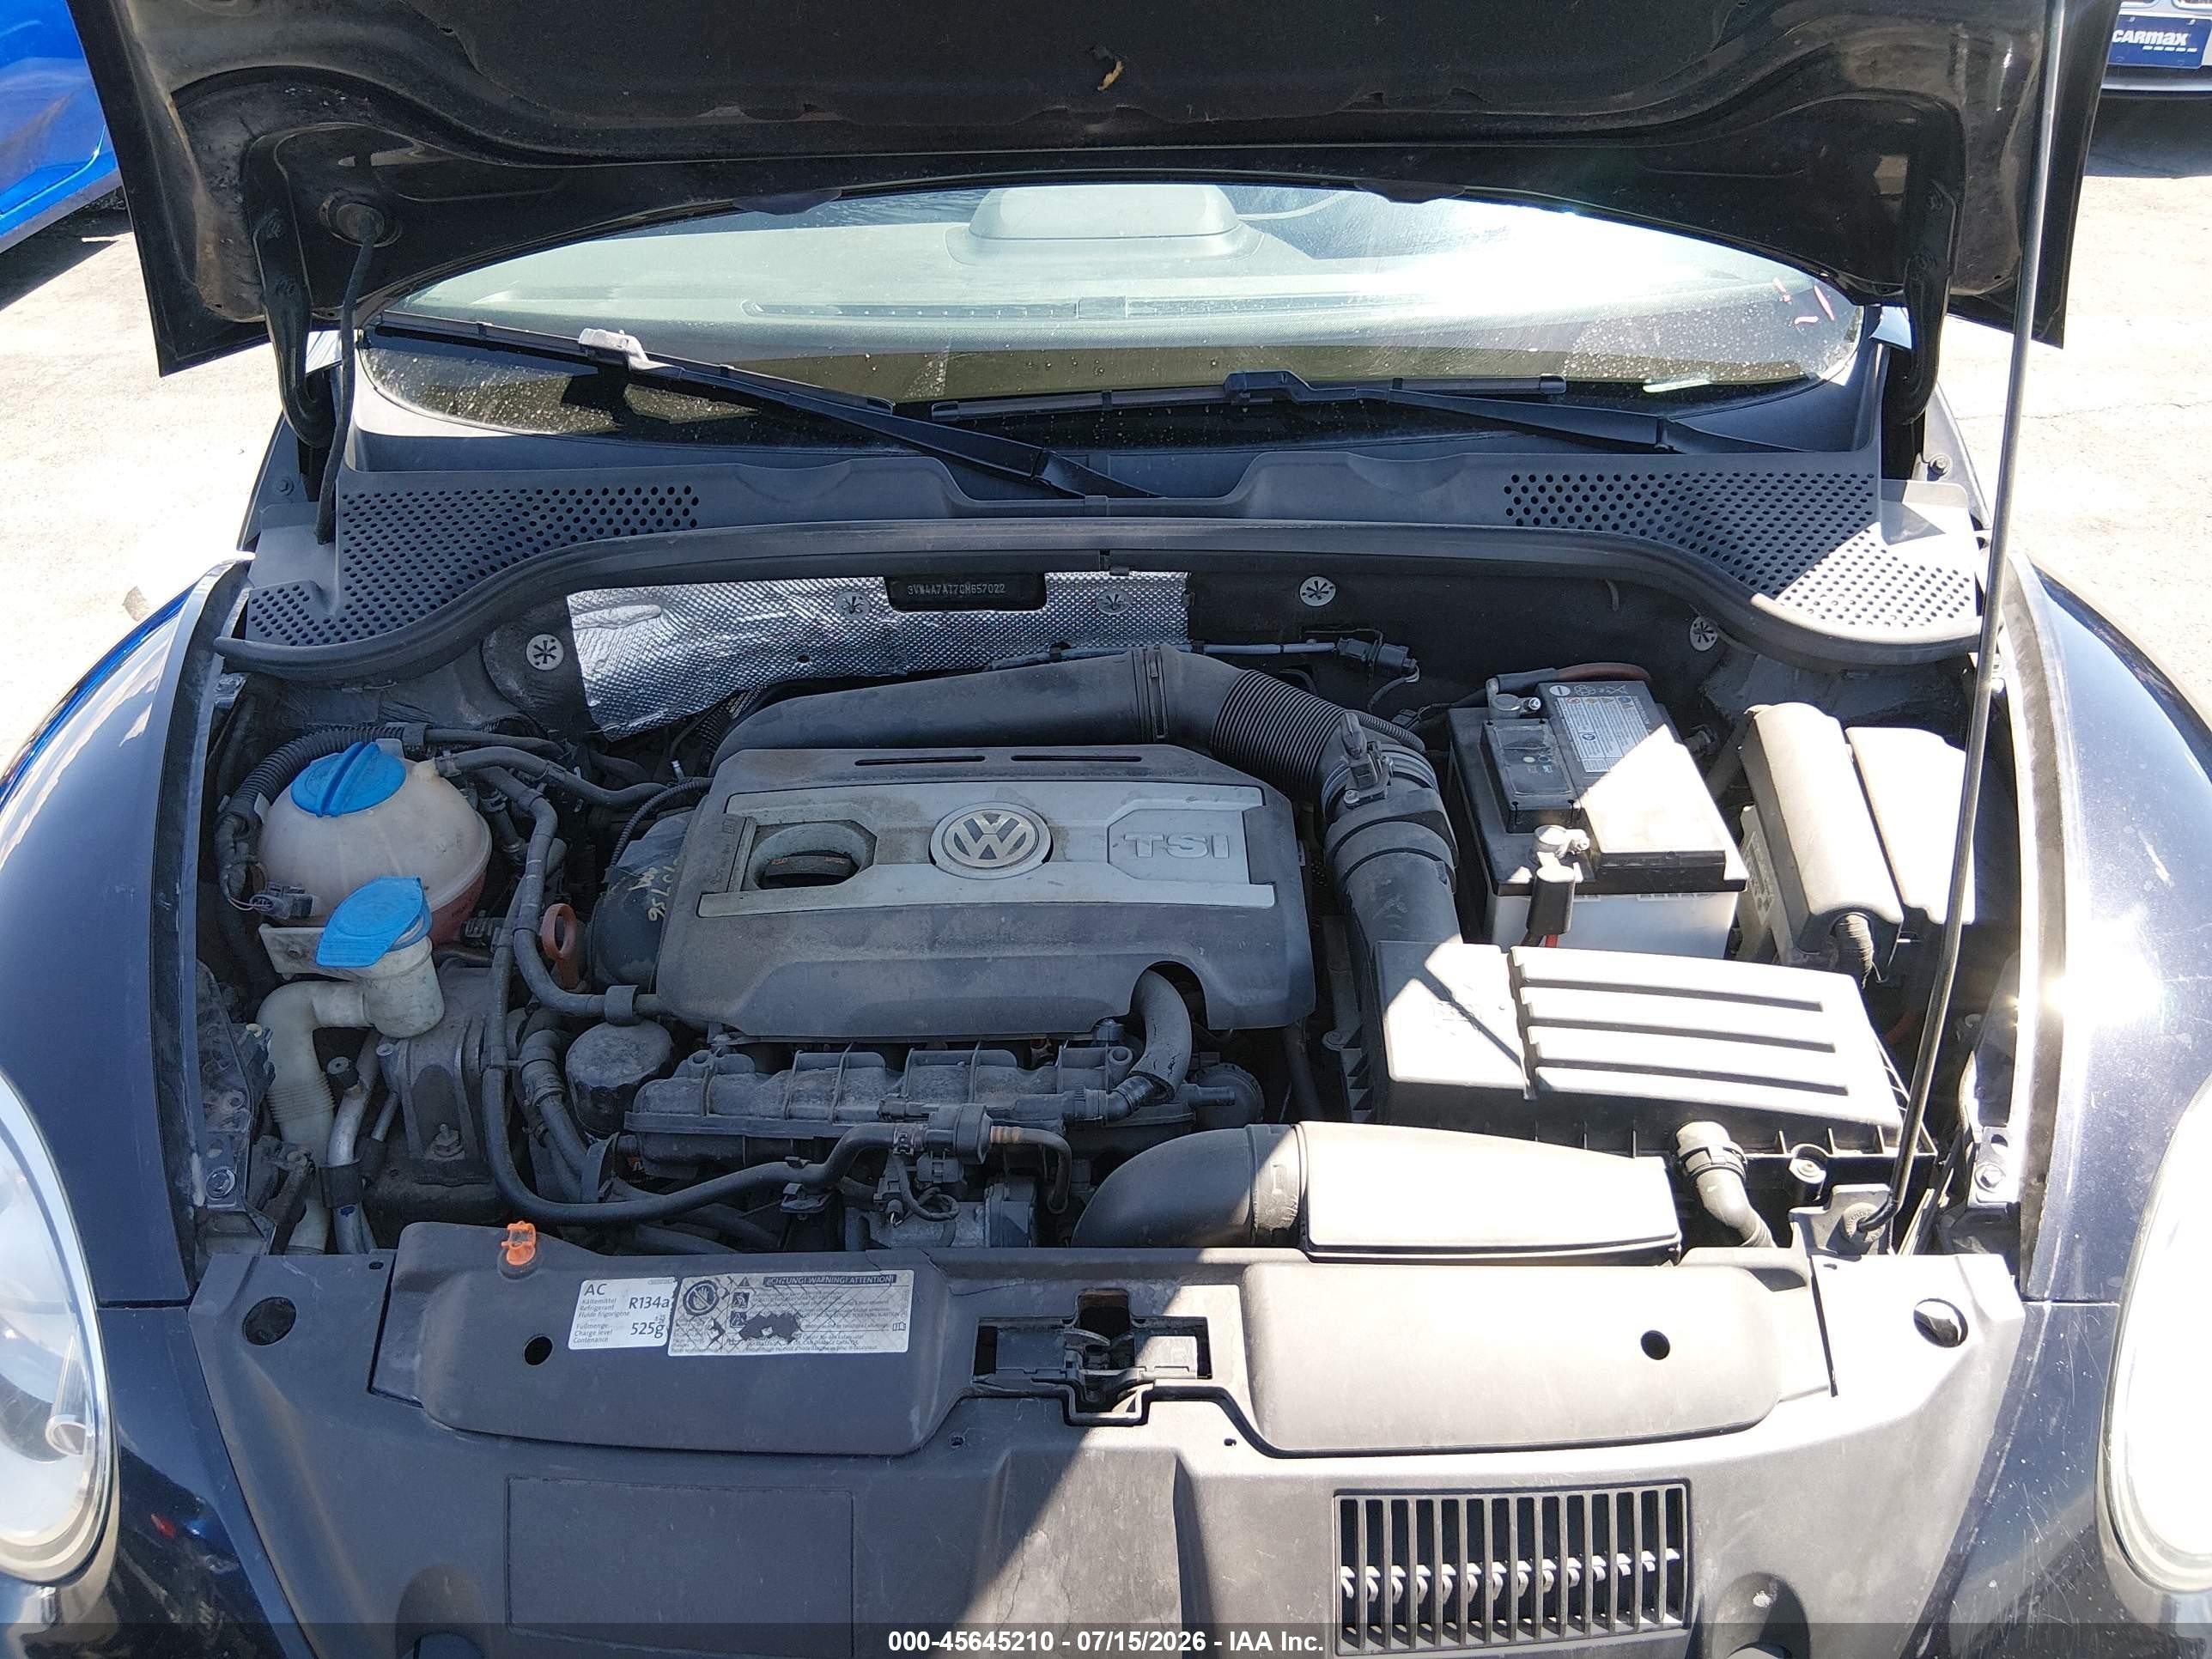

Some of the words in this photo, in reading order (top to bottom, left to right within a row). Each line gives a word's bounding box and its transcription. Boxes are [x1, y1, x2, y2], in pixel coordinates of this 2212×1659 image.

[1124, 833, 1230, 859] TSI
[849, 1275, 894, 1284] ATTENTION!
[584, 1284, 607, 1296] AC
[629, 1296, 670, 1310] R134a
[630, 1322, 665, 1339] 525g
